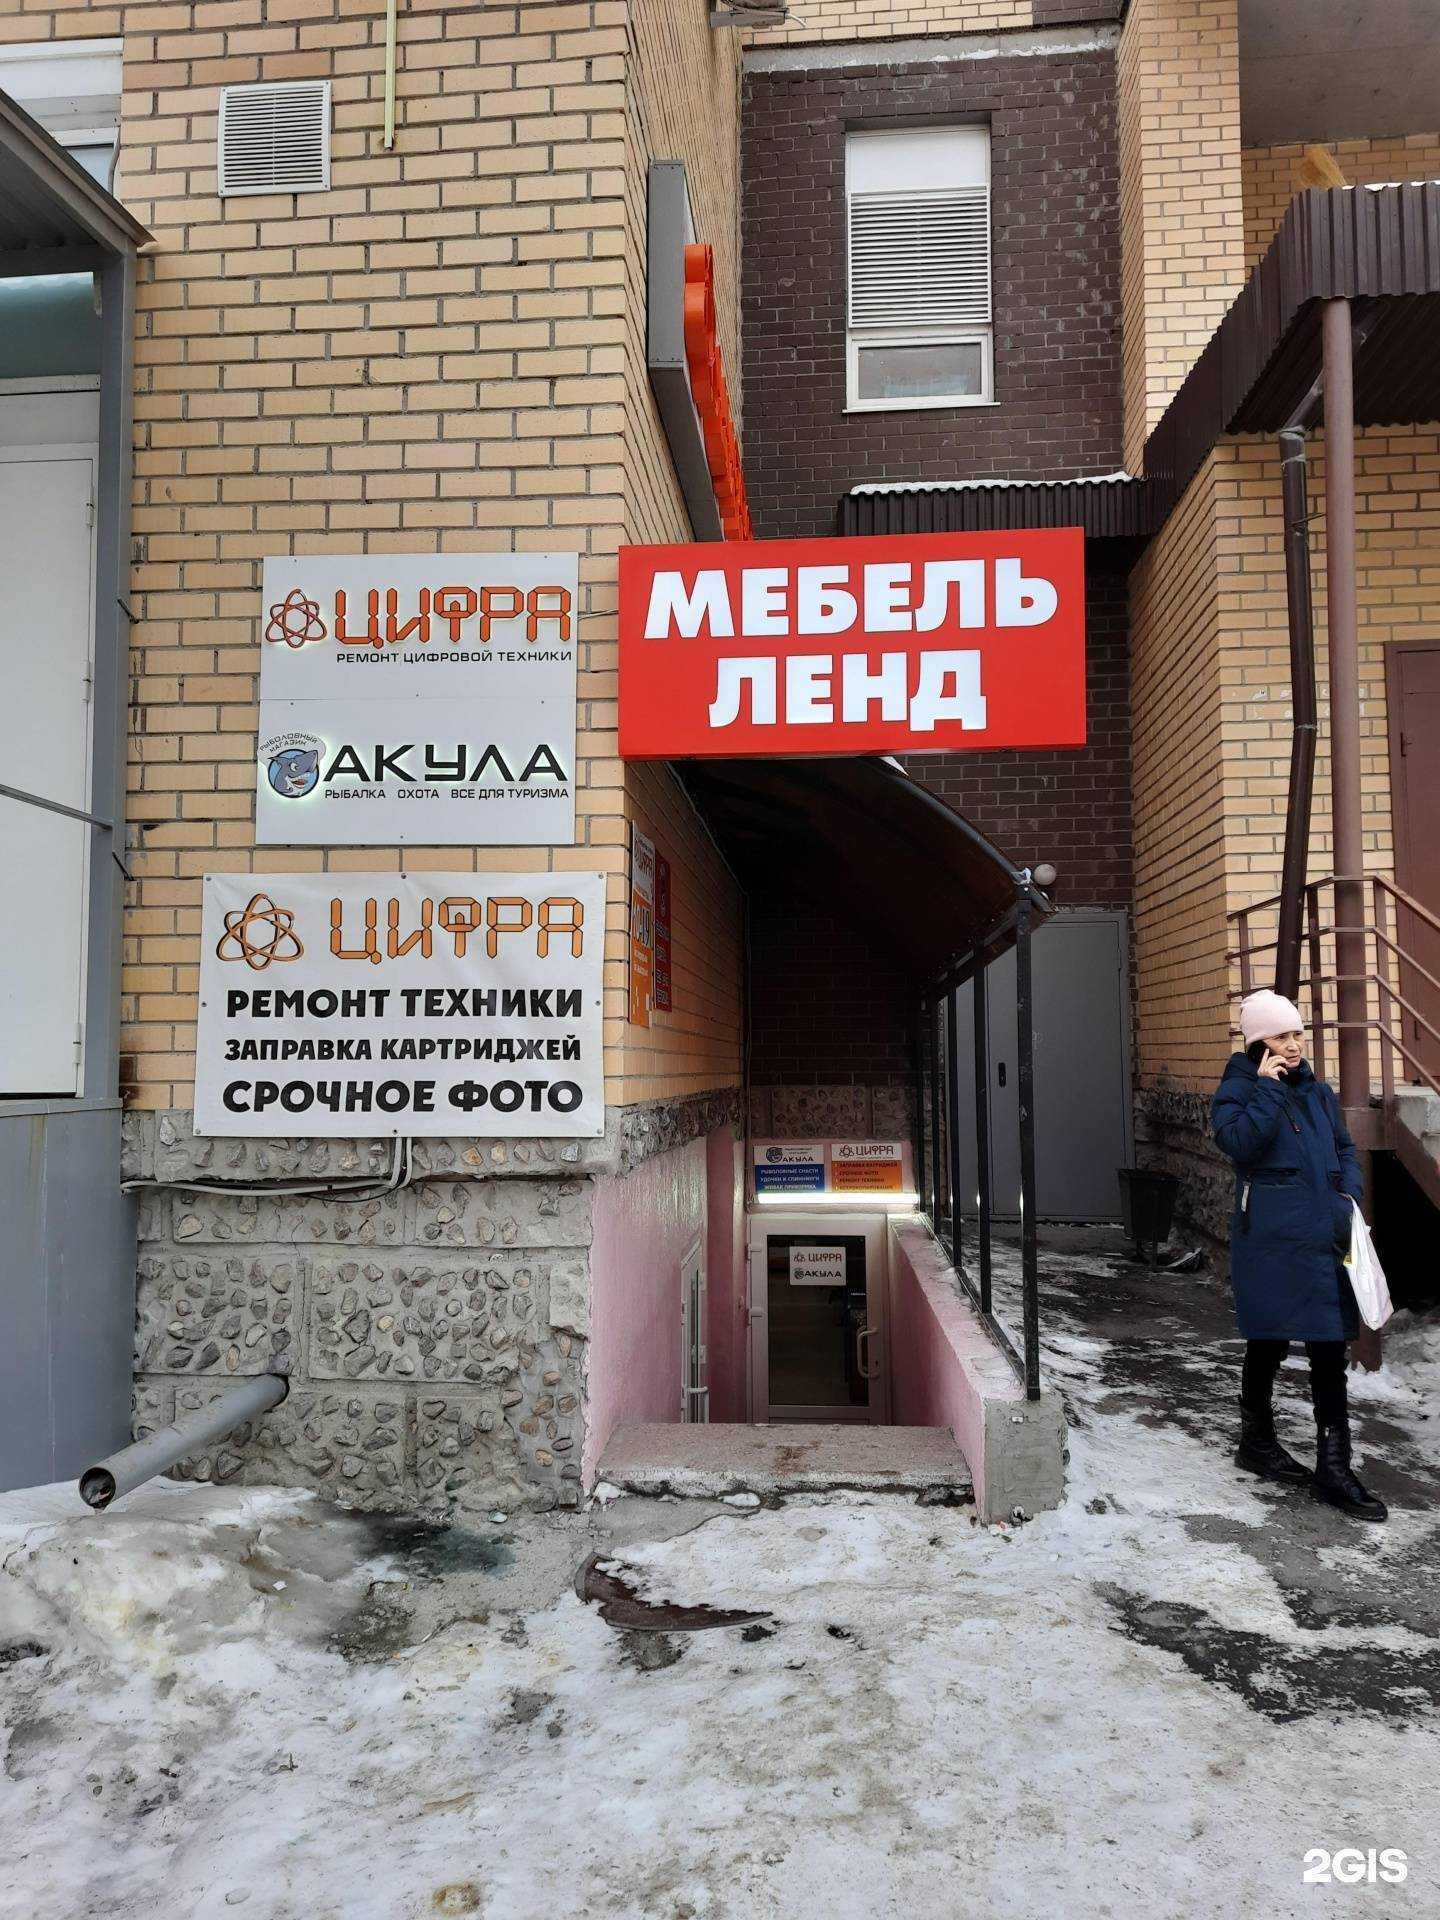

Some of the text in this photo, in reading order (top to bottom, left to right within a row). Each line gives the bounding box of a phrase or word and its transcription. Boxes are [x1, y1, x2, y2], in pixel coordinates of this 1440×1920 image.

[644, 558, 1058, 639] МЕБЕЛЬ
[335, 586, 571, 649] ЦИФРА
[336, 649, 572, 665] РЕМОНТ ЦИФРОВОЙ ТЕХНИКИ
[709, 649, 987, 731] ЛЕНД
[260, 732, 318, 751] РЫБОЛОВНЫЙ
[269, 739, 307, 752] МАГАЗИН
[323, 744, 568, 782] АКУЛА
[324, 788, 569, 801] РЫБАЛКА ОХОТА ВСЕ ДЛЯ ТУРИЗМА
[330, 896, 584, 965] ЦИФРА
[226, 988, 582, 1018] РЕМОНТ ТЕХНИКИ
[224, 1035, 581, 1063] ЗАПРАВКА КАРТРИДЖЕЙ
[222, 1080, 583, 1113] СРОЧНОЕ ФОТО
[855, 1145, 894, 1156] ЦИФРА
[808, 1252, 842, 1263] ЦИФРА
[804, 1270, 842, 1278] АКУЛА
